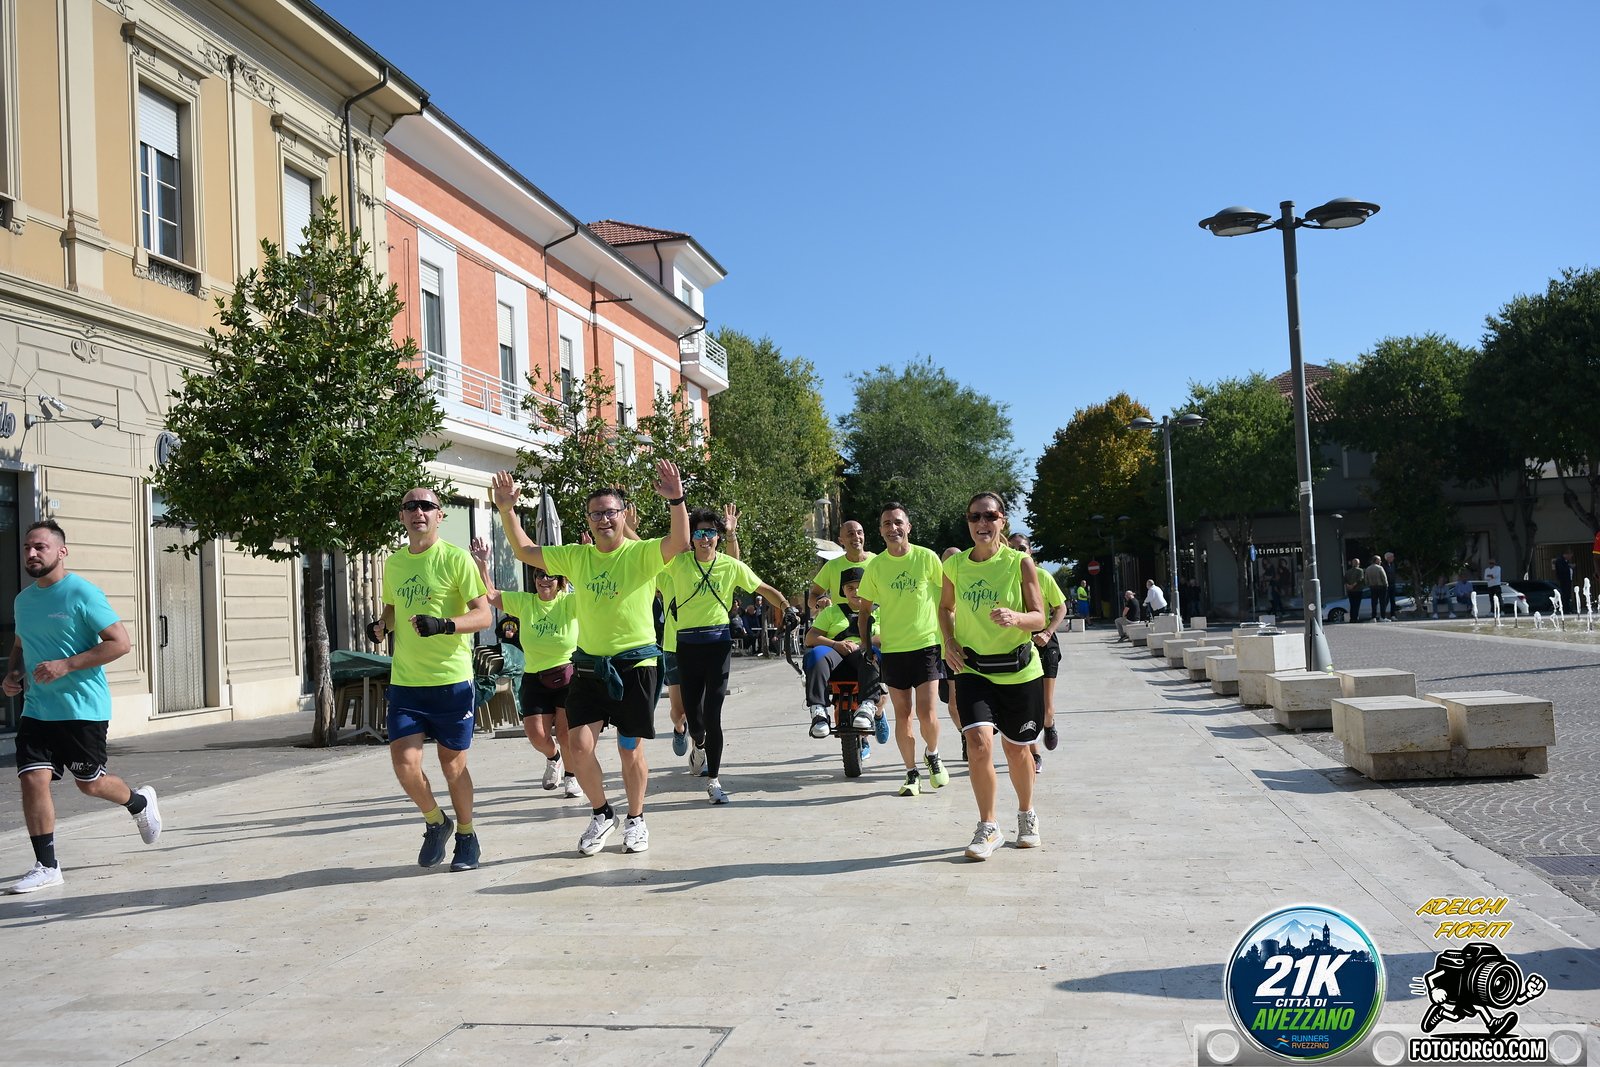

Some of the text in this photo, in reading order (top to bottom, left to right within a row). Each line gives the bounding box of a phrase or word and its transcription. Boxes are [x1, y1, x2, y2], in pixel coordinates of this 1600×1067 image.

[395, 583, 432, 609] enjoy
[585, 581, 618, 603] enjoy
[890, 577, 917, 598] enjoy
[962, 588, 999, 613] enjoy
[531, 621, 559, 638] enjoy
[70, 761, 84, 771] NYC
